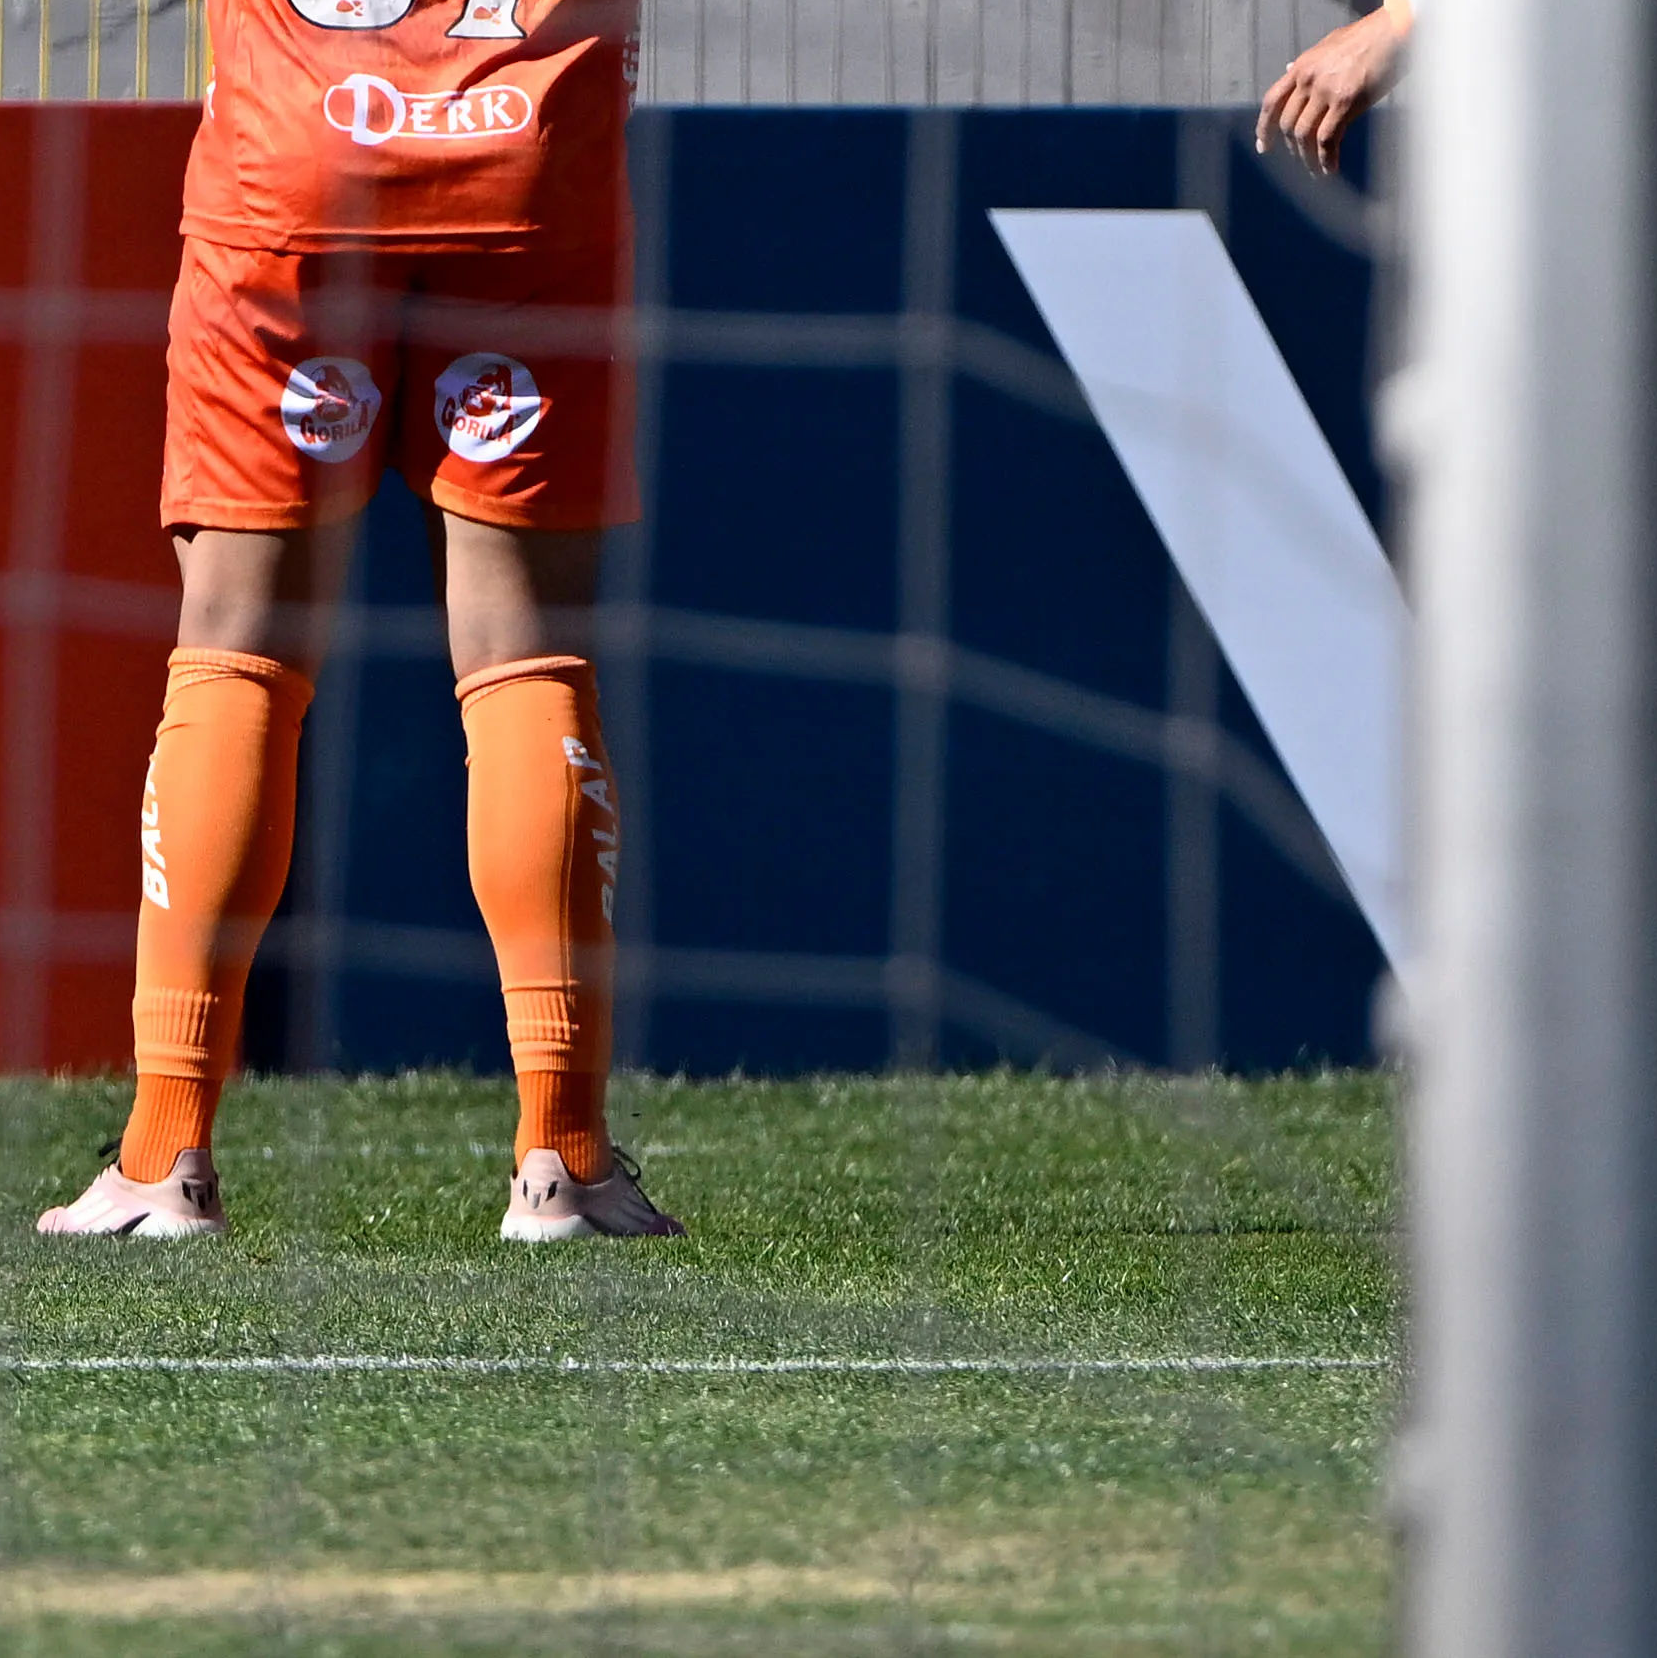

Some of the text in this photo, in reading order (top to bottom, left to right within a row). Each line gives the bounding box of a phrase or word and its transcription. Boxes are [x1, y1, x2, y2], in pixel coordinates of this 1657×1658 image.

[342, 73, 516, 146] DERK
[298, 400, 373, 446] GORILA
[442, 396, 520, 446] GORILA
